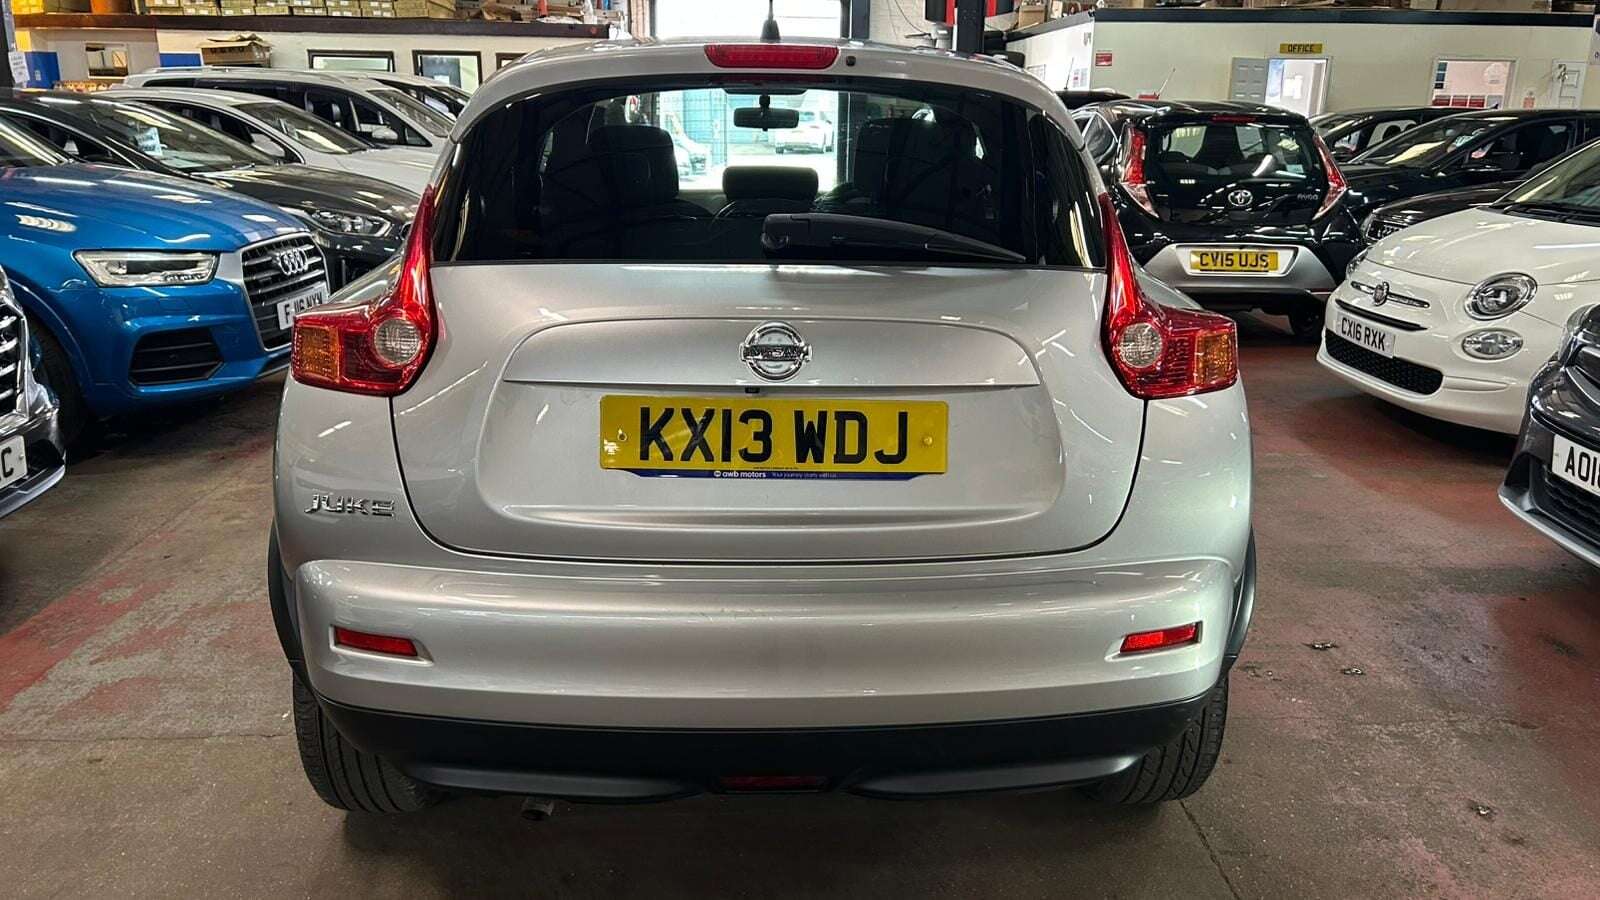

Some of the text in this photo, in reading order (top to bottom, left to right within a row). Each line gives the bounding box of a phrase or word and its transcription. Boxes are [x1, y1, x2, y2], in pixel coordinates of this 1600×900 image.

[1287, 43, 1314, 53] OFFICE
[1200, 252, 1269, 268] CV15 UJS
[1341, 317, 1386, 351] CX16 RXK
[639, 406, 908, 465] KX13 WDJ
[0, 446, 14, 479] C
[740, 471, 767, 479] motors
[1565, 446, 1600, 488] AO1
[304, 494, 394, 517] JUKE
